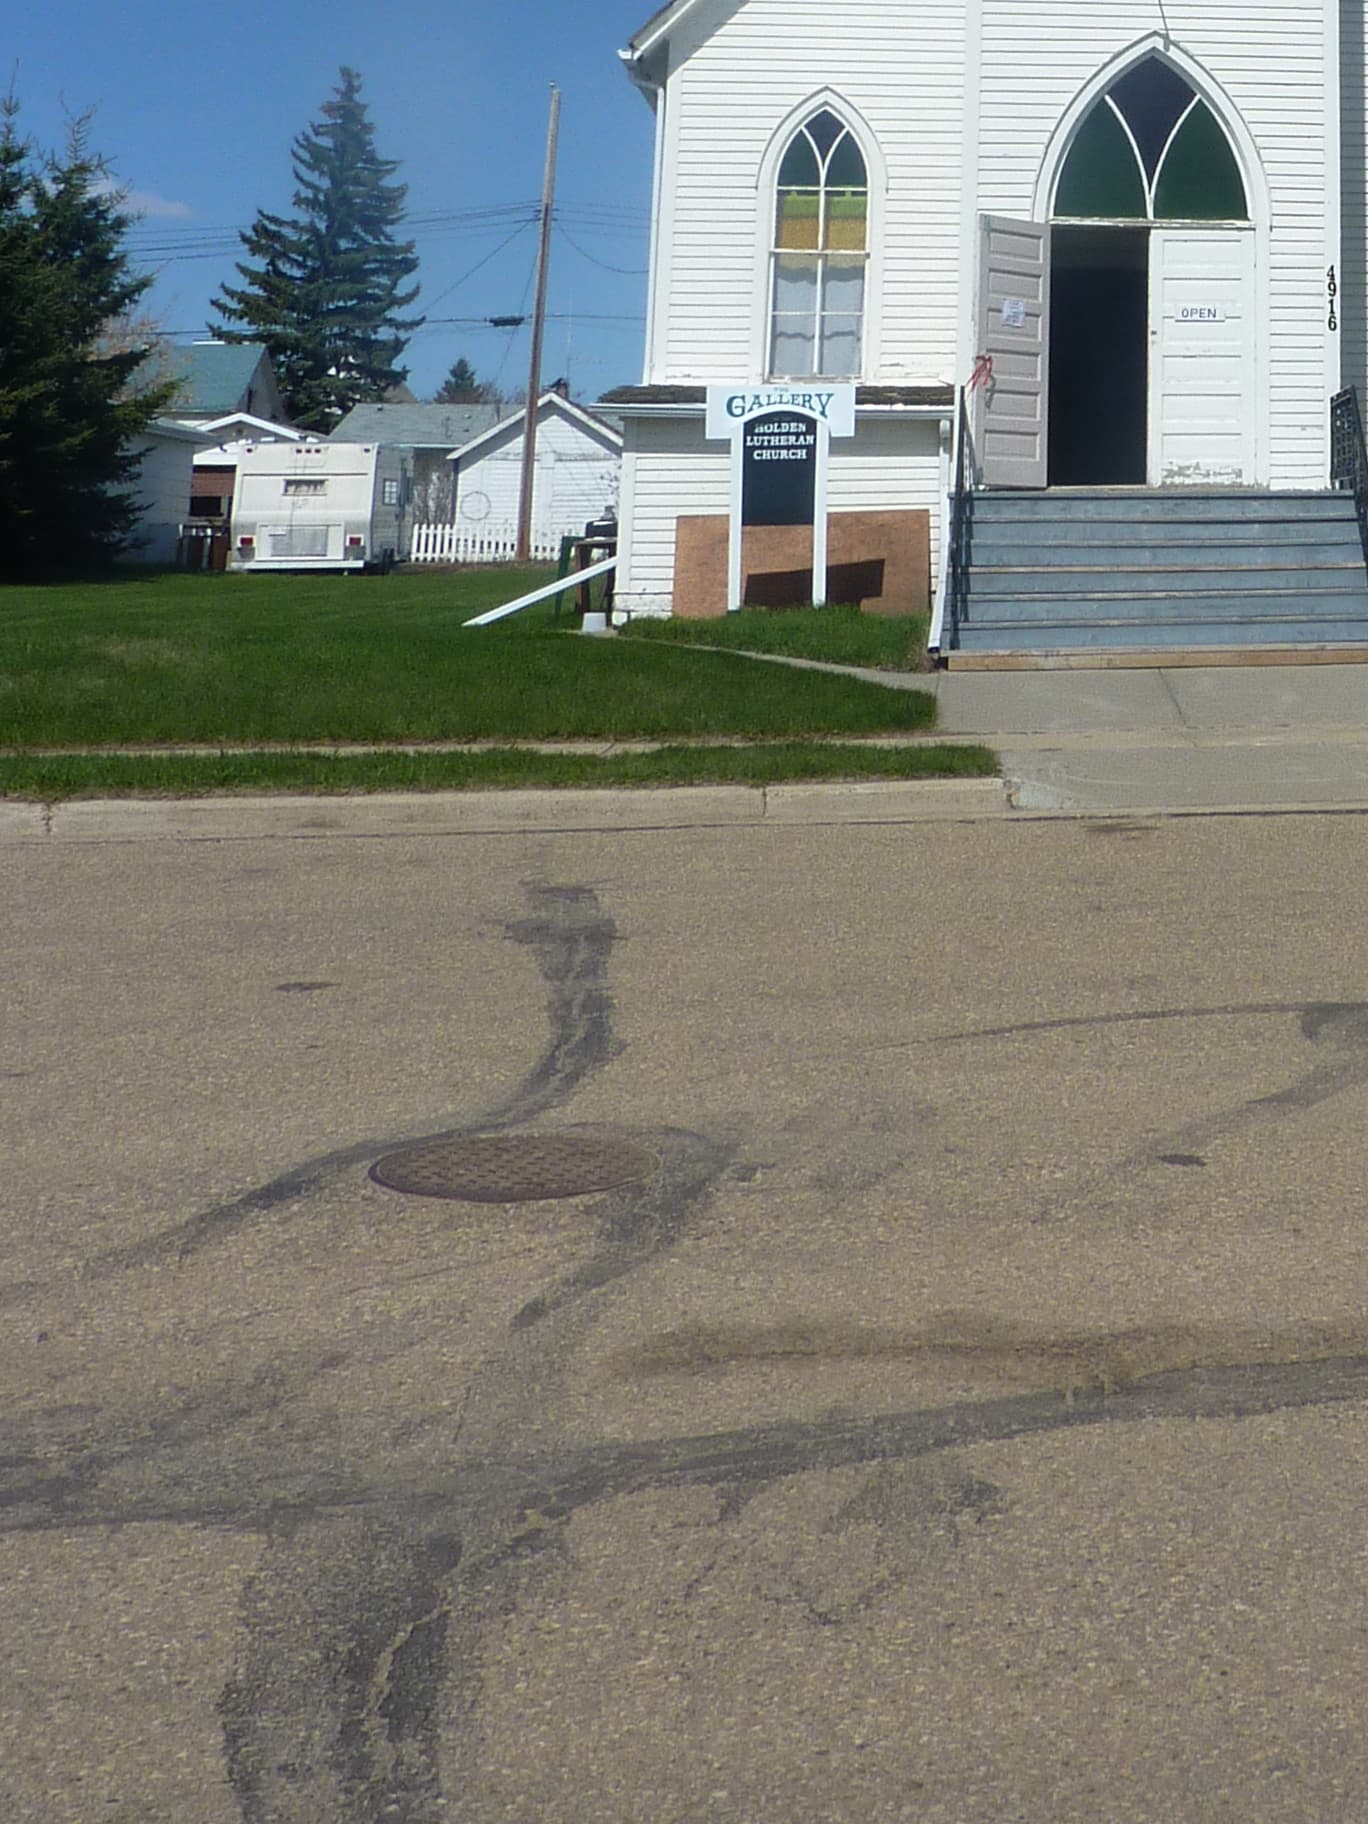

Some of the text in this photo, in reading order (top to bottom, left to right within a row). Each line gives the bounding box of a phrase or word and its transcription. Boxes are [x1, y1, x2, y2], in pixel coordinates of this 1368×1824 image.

[1326, 264, 1337, 331] 4916
[1181, 308, 1217, 318] OPEN
[726, 393, 834, 418] GALLERY
[754, 423, 807, 433] HOLDEN
[746, 435, 815, 446] LUTHERAN
[753, 449, 808, 460] CHURCH
